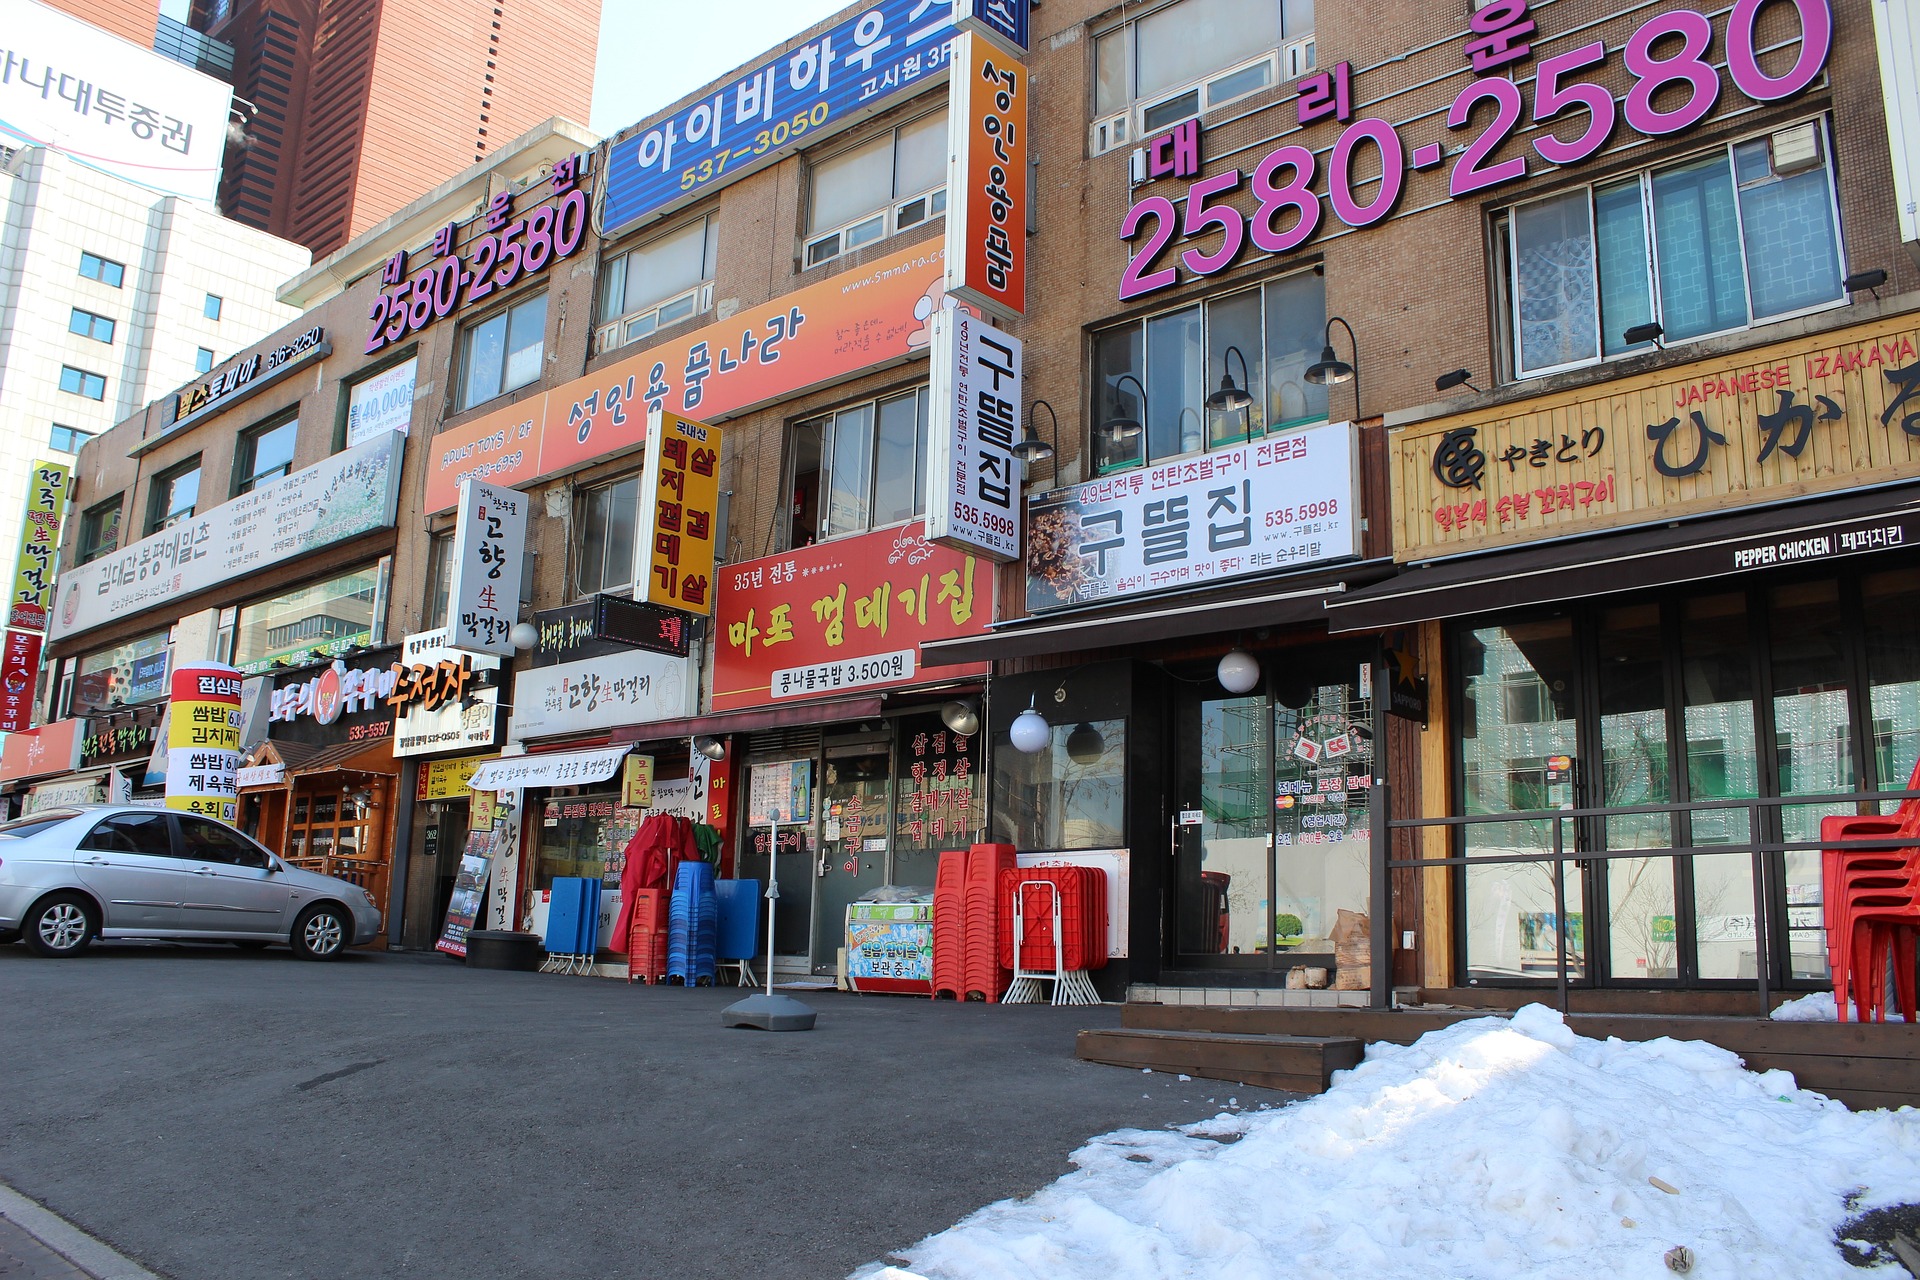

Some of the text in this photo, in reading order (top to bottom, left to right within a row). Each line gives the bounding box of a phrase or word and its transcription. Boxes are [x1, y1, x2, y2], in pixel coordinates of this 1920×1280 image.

[858, 55, 922, 102] 고시원
[680, 101, 829, 190] 537-3050
[1119, 0, 1833, 300] 2580-2580
[981, 59, 1017, 293] 성인용품
[364, 189, 586, 354] 2580-2580
[177, 353, 261, 420] 헬스토피아
[267, 326, 321, 370] 516-3250
[567, 305, 806, 444] 성인용품나라
[1675, 336, 1917, 409] JAPANESE IZAKAYA
[676, 420, 707, 442] 국내산
[977, 333, 1015, 510] 구뜰집
[441, 443, 475, 472] ADULT
[477, 429, 505, 453] TOYS
[517, 419, 534, 441] 2F
[1498, 425, 1605, 474] やきとり
[39, 469, 62, 511] 전주
[1079, 435, 1308, 505] 49년전통 연탄초벌구이 전문점
[493, 497, 517, 516] 찬우물
[654, 437, 688, 599] 돼지껍데기
[953, 500, 1015, 538] 535.5998
[1264, 498, 1339, 529] 535.5998
[1435, 498, 1487, 533] 일본식
[1535, 473, 1615, 516] 꼬치구이
[478, 515, 506, 580] 고향
[682, 448, 716, 606] 삼겹살
[952, 522, 1015, 552] www.구뜰집.kr
[1078, 478, 1252, 576] 구뜰집
[1263, 520, 1340, 542] www.구뜰집.kr
[1734, 525, 1903, 569] PEPPER CHICKEN 페퍼치킨
[19, 543, 52, 605] 막걸리
[734, 559, 797, 591] 35년 전통
[1080, 581, 1110, 600] 구뜰은
[1150, 566, 1191, 586] 구수하며
[1194, 560, 1216, 578] 맛이
[1250, 550, 1273, 567] 라는
[1276, 541, 1322, 563] 순우리말
[477, 584, 499, 612] 生
[728, 602, 795, 658] 마포
[811, 555, 976, 647] 껍데기집
[11, 634, 29, 666] 모두의
[462, 612, 511, 645] 막걸리
[387, 654, 472, 718] 주전자
[569, 673, 650, 713] 고향 生 막걸리
[780, 654, 904, 694] 콩나물국밥 3.500원
[192, 705, 226, 723] 쌈밥
[269, 677, 318, 722] 모두의
[349, 721, 391, 741] 533-5597
[190, 753, 224, 770] 쌈밥
[506, 766, 529, 781] 참꼬막
[531, 764, 551, 777] 개시!
[556, 762, 579, 780] 굴굴굴
[582, 757, 618, 776] 통영생굴!
[910, 757, 971, 785] 항정살
[909, 786, 973, 813] 갈매기살
[1278, 774, 1372, 795] 전메뉴 포장 판매
[843, 794, 862, 878] 소금구이
[909, 815, 968, 842] 껍데기
[1277, 832, 1292, 847] 오전
[871, 961, 890, 976] 보관
